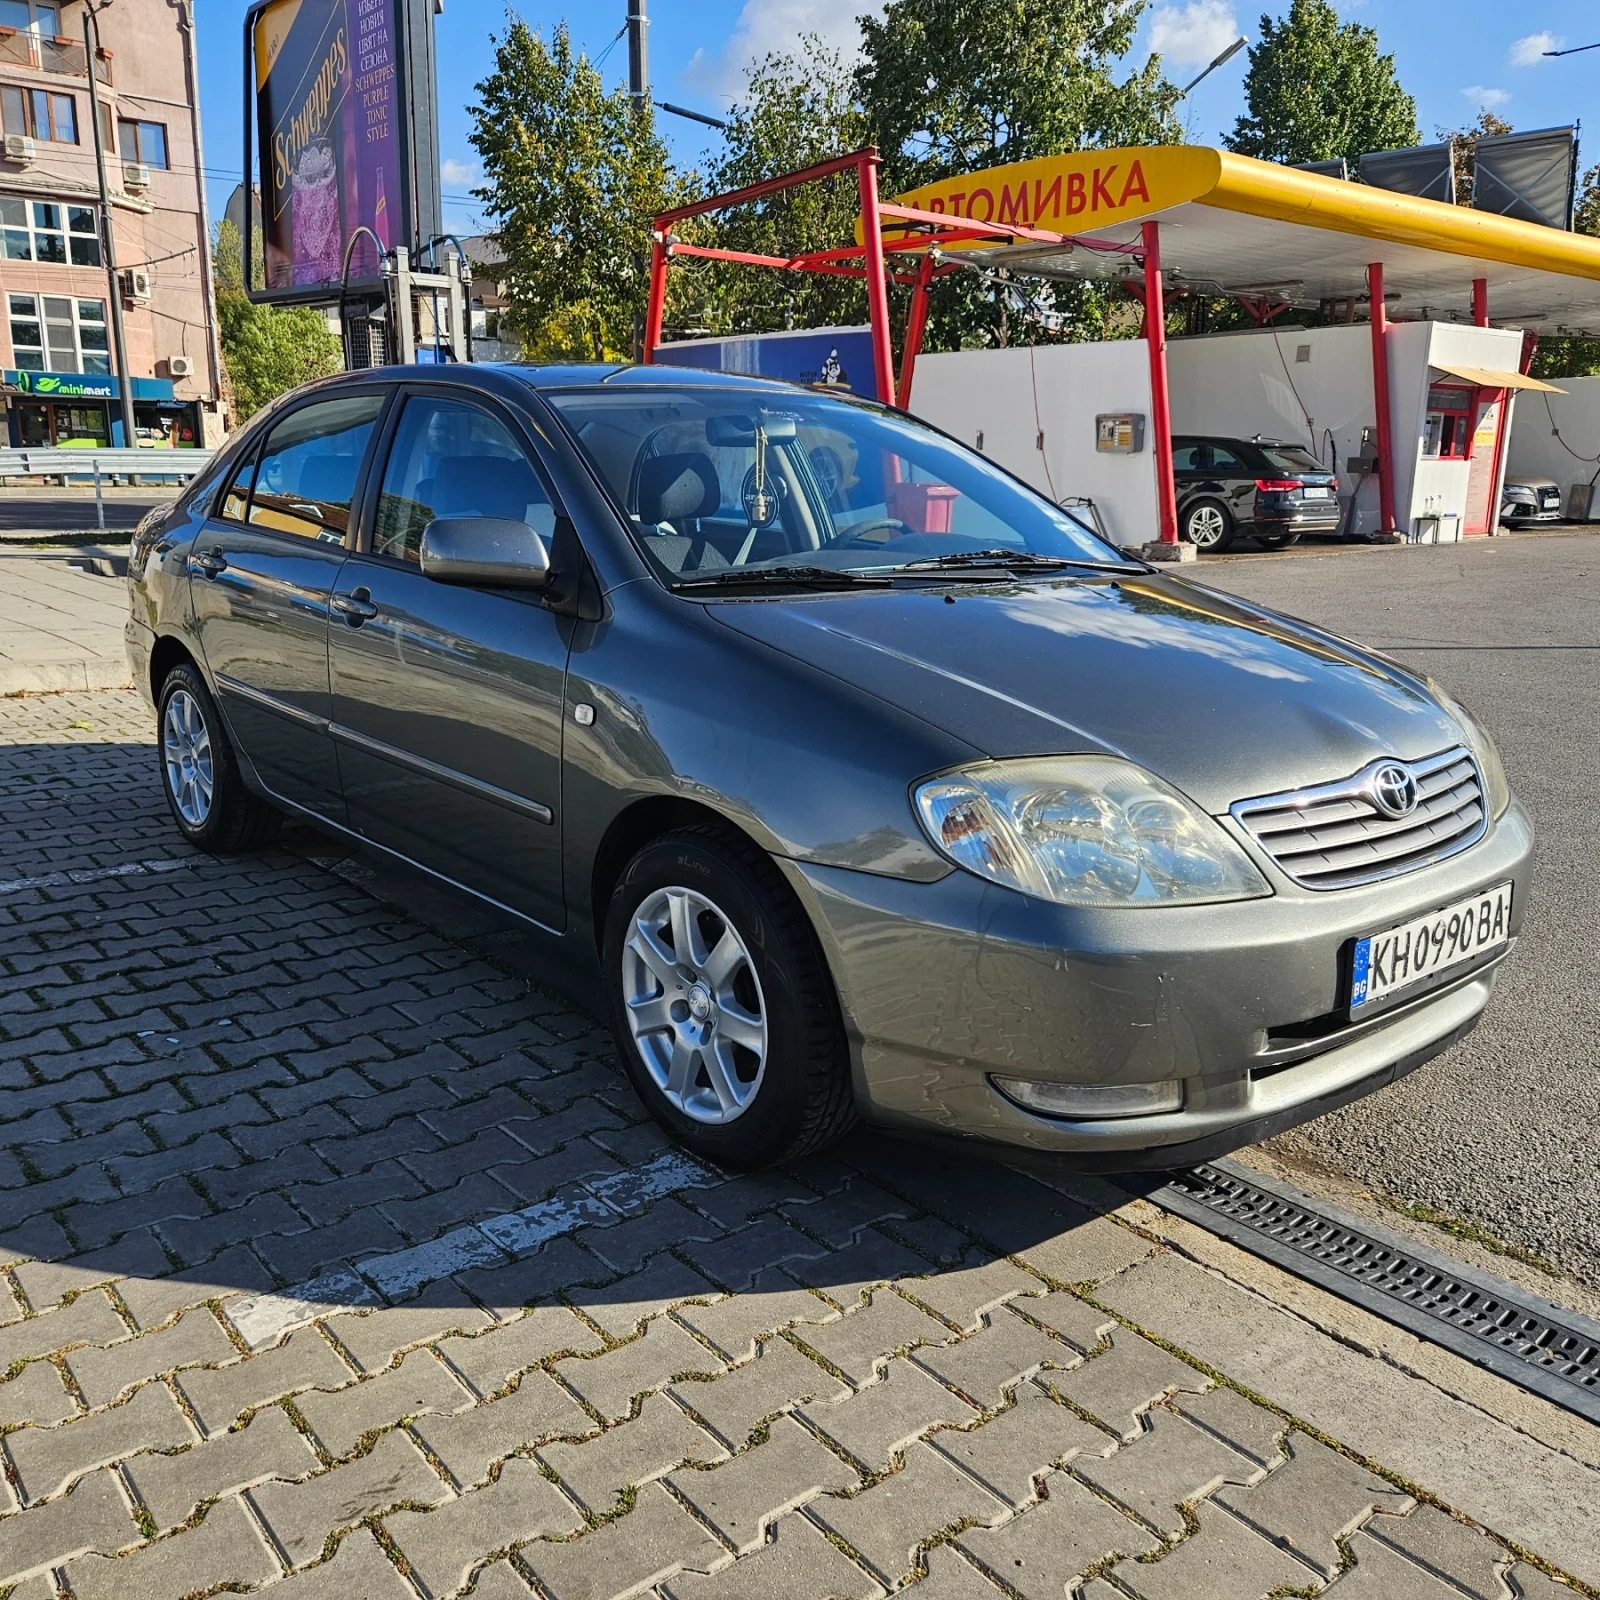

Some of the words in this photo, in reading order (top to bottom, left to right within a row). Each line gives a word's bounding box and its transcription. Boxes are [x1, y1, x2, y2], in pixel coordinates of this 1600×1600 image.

[360, 9, 384, 35] НОВИЯ
[358, 30, 376, 55] ЦВЯТ
[377, 27, 388, 46] НА
[360, 47, 388, 72] СЕЗОНА
[355, 63, 395, 93] SCHWEPPES
[275, 27, 346, 190] Schweppes
[363, 85, 389, 108] PURPLE
[366, 104, 388, 125] TONIC
[366, 122, 389, 143] STYLE
[58, 383, 112, 396] minimart
[1371, 893, 1504, 992] KH0990BA
[1353, 979, 1367, 997] BG
